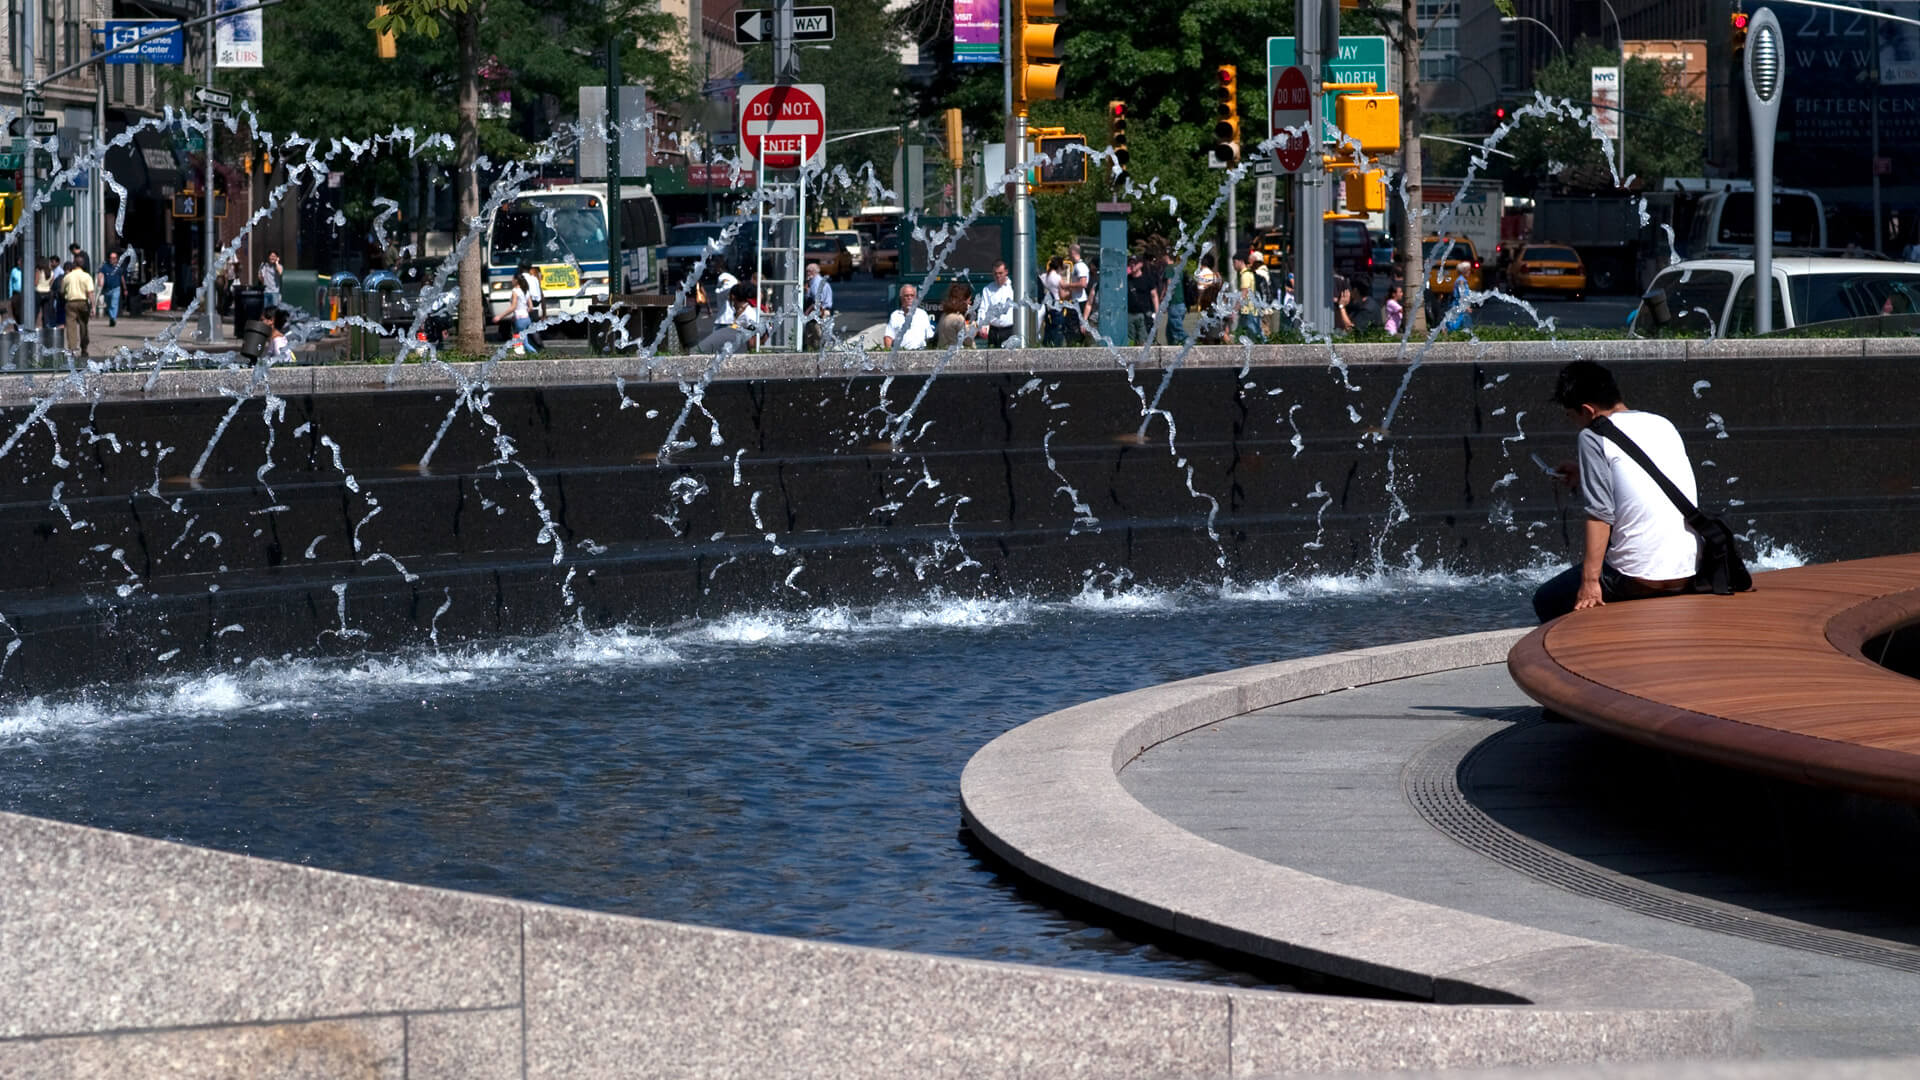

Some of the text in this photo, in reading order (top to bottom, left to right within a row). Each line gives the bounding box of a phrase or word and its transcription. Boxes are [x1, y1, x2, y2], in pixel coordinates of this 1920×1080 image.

[954, 13, 973, 21] VISIT
[795, 17, 823, 31] WAY
[140, 45, 169, 54] Center
[235, 50, 258, 62] UBS
[1335, 71, 1376, 84] NORTH
[1594, 73, 1615, 81] NYC
[1277, 87, 1307, 104] DO NOT
[753, 102, 811, 116] DO NOT
[1795, 98, 1871, 113] FIFTEEN
